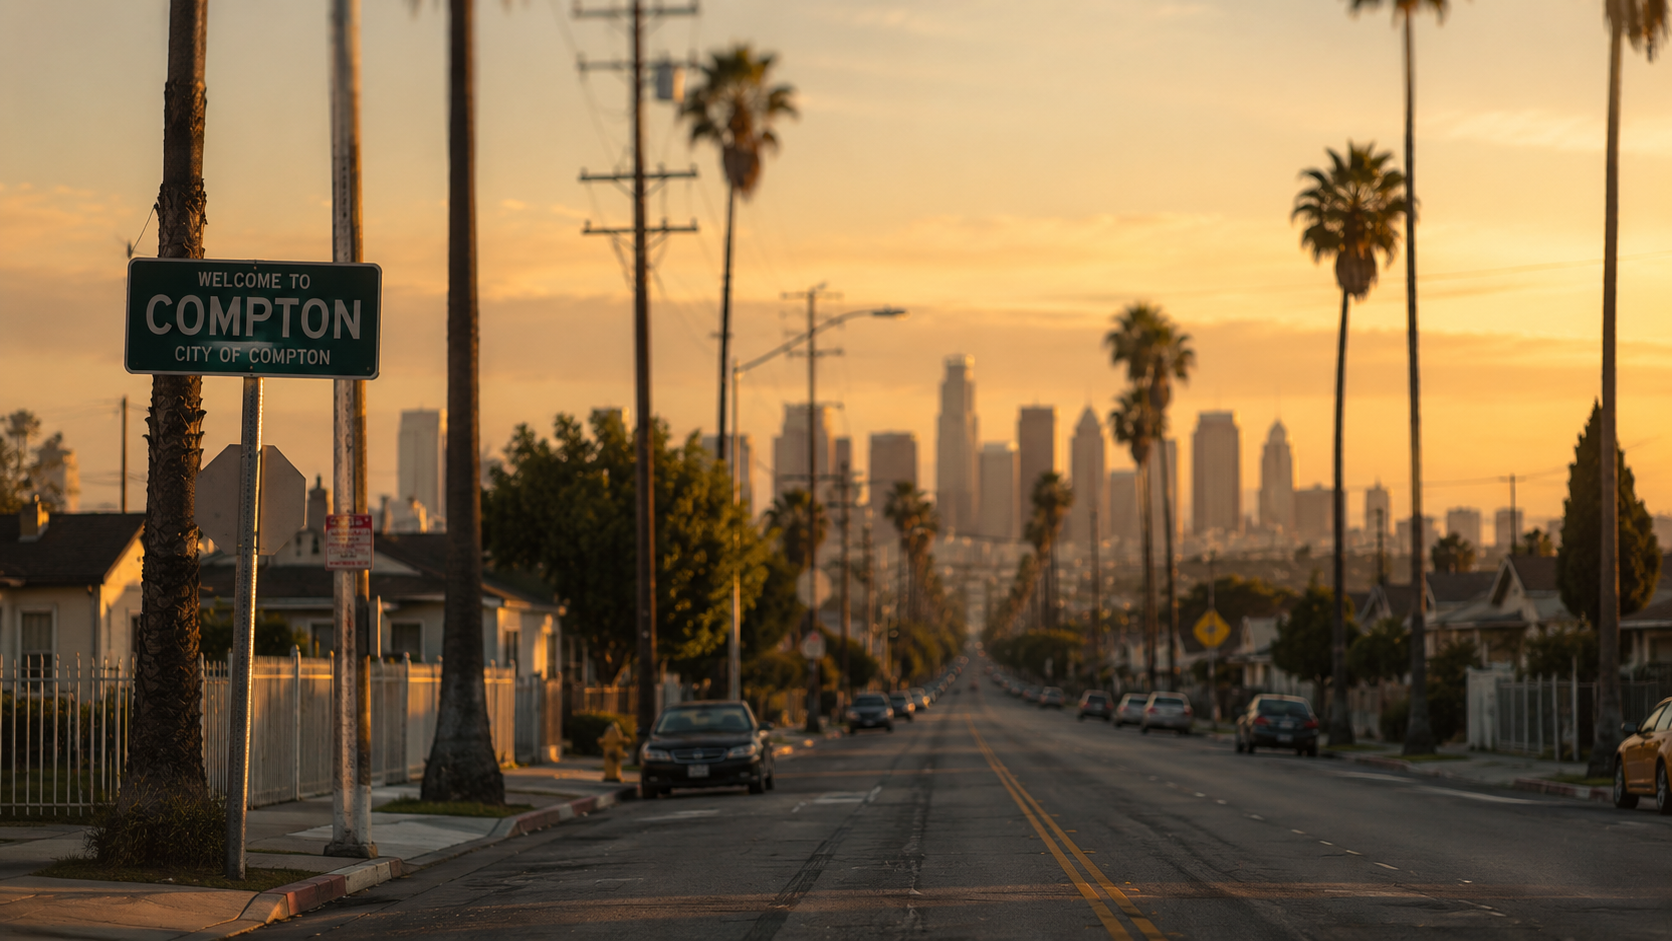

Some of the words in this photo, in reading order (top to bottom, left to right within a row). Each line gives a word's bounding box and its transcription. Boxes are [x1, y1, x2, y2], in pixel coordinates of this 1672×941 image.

[198, 271, 281, 289] WELCOME
[289, 273, 311, 290] TO
[146, 294, 361, 340] COMPTON
[175, 345, 212, 363] CITY
[219, 346, 241, 363] OF
[248, 347, 331, 365] COMPTON
